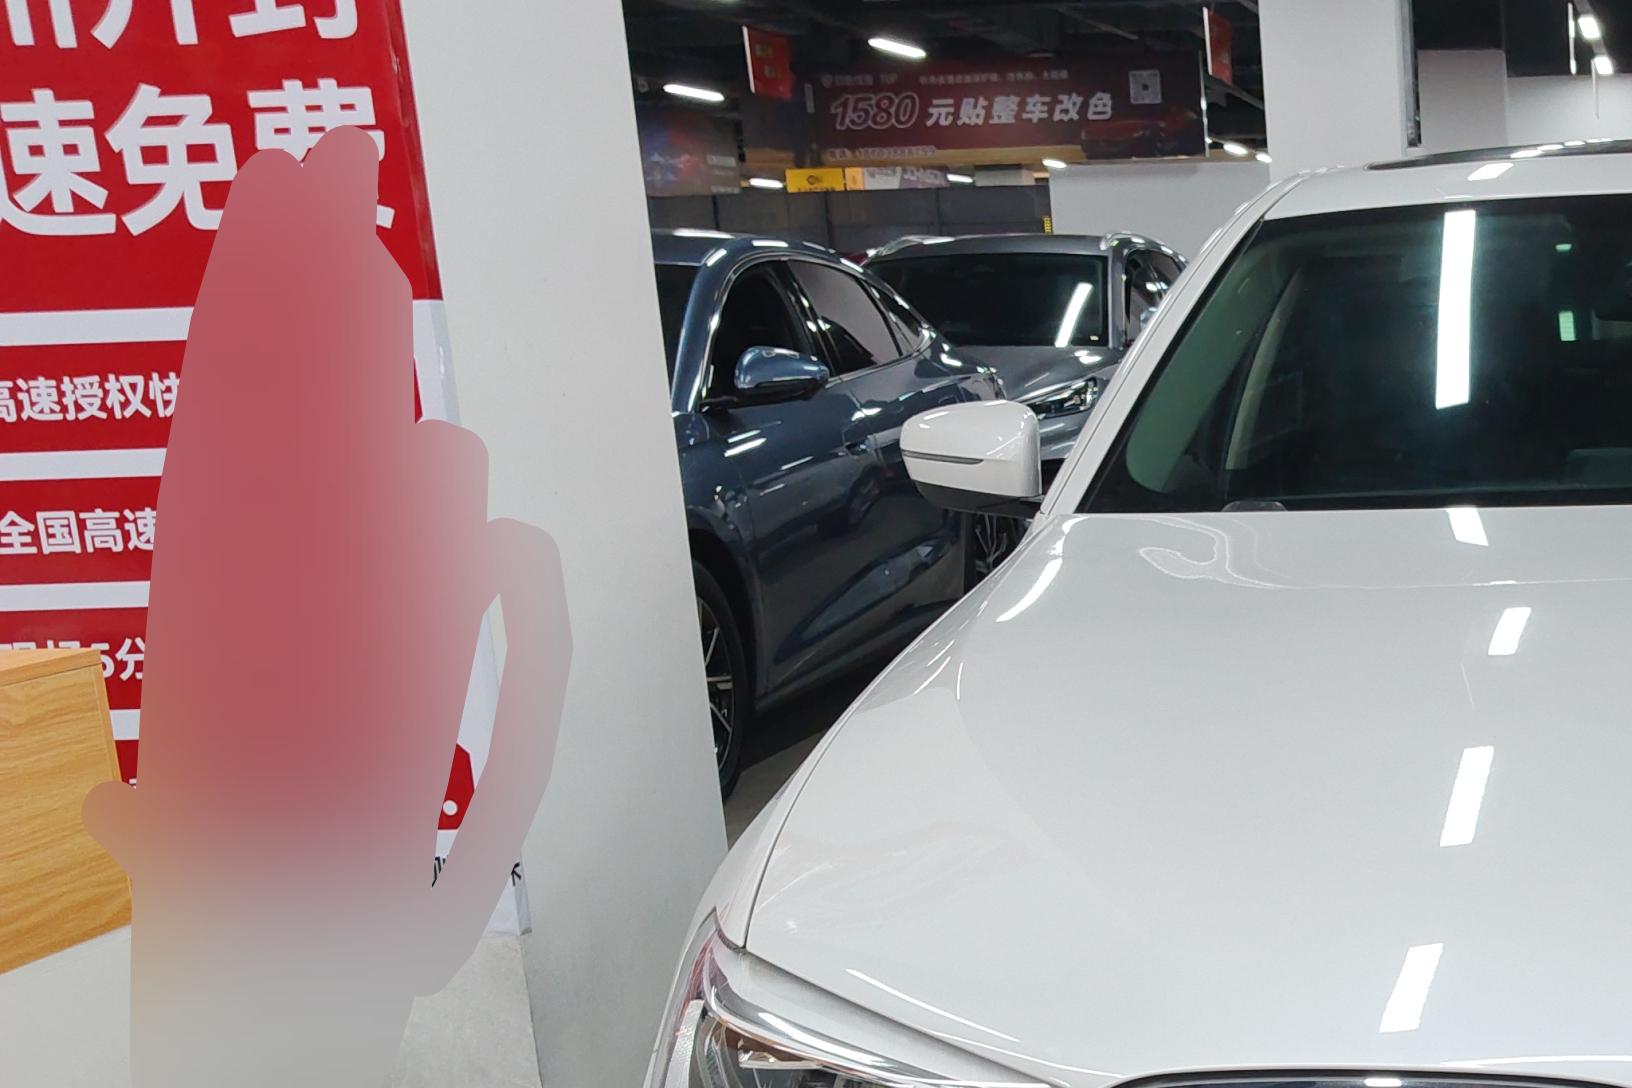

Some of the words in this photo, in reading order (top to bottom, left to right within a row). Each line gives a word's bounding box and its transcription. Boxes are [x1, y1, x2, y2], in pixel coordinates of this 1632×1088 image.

[830, 92, 920, 130] 1580
[926, 92, 1113, 127] 元贴整车改色
[0, 507, 157, 556] 全国高速
